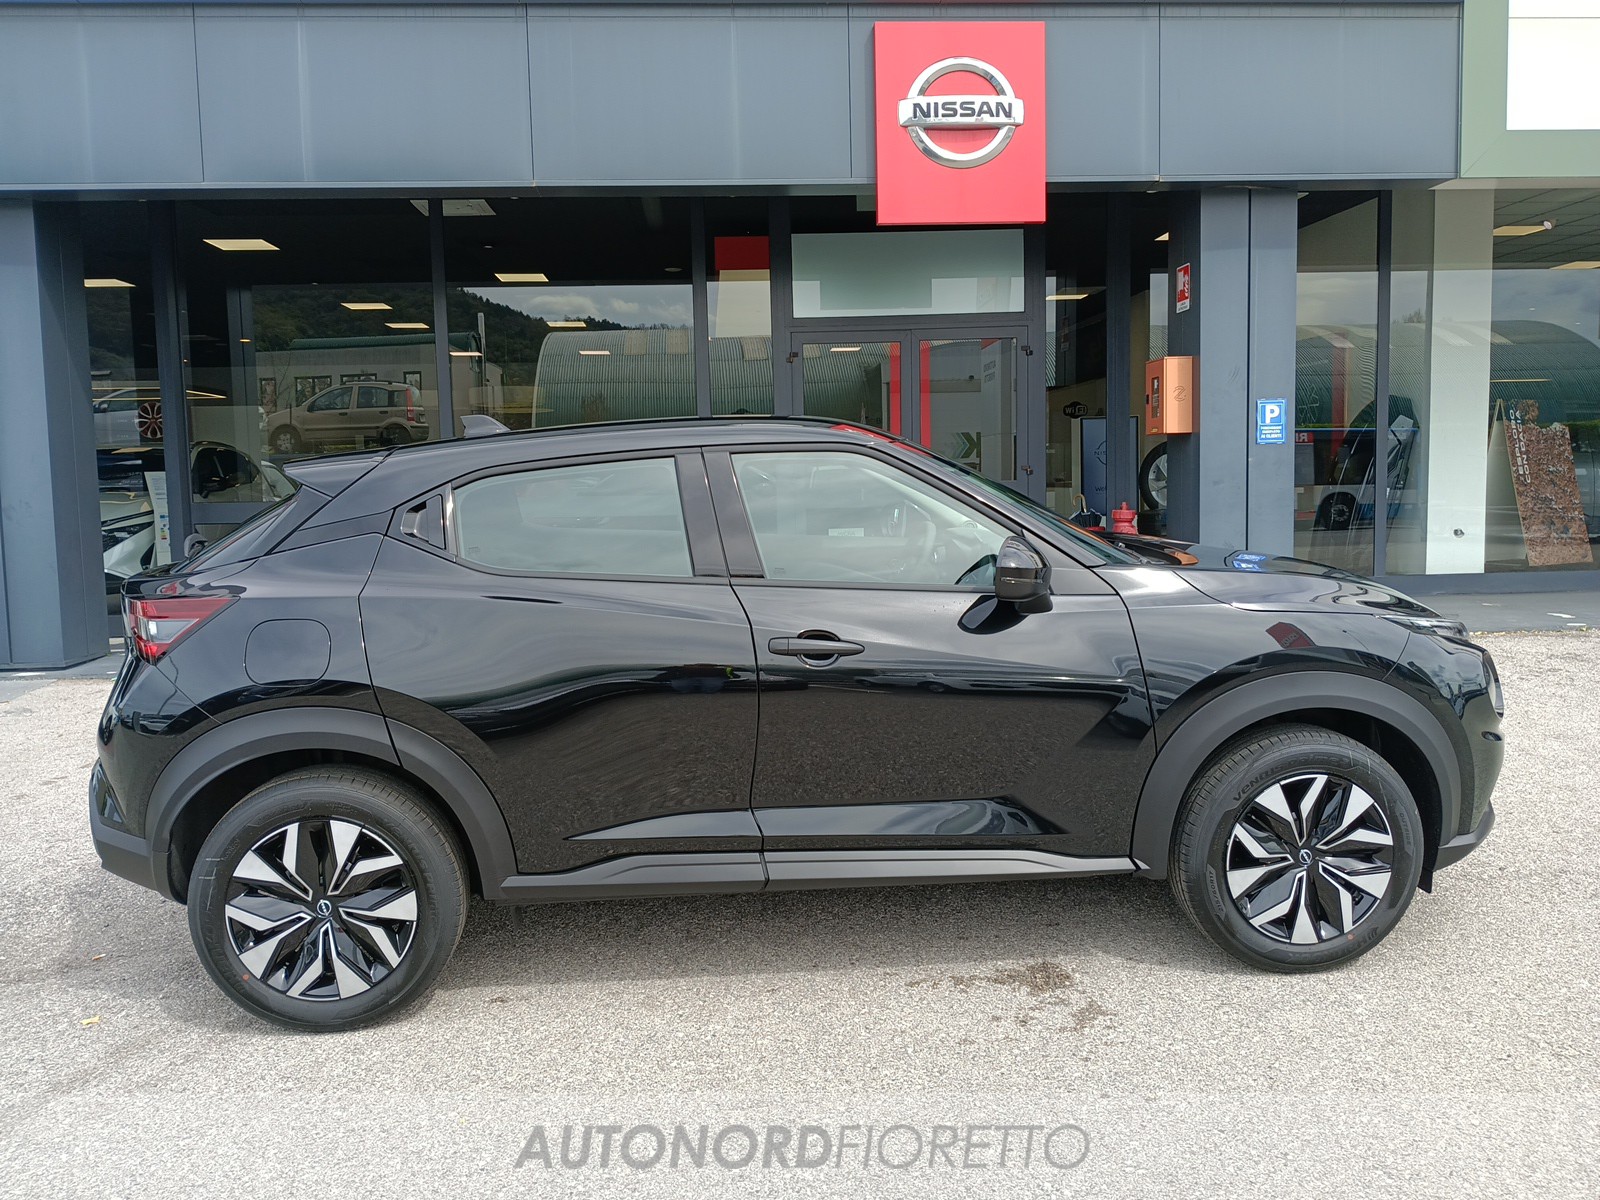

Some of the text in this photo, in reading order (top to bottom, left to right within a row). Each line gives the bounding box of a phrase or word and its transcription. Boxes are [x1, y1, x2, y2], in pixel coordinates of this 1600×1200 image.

[912, 101, 1013, 119] NISSAN
[1265, 404, 1280, 424] P
[1509, 409, 1524, 475] ESPLORO
[1515, 410, 1531, 483] CON DACIA
